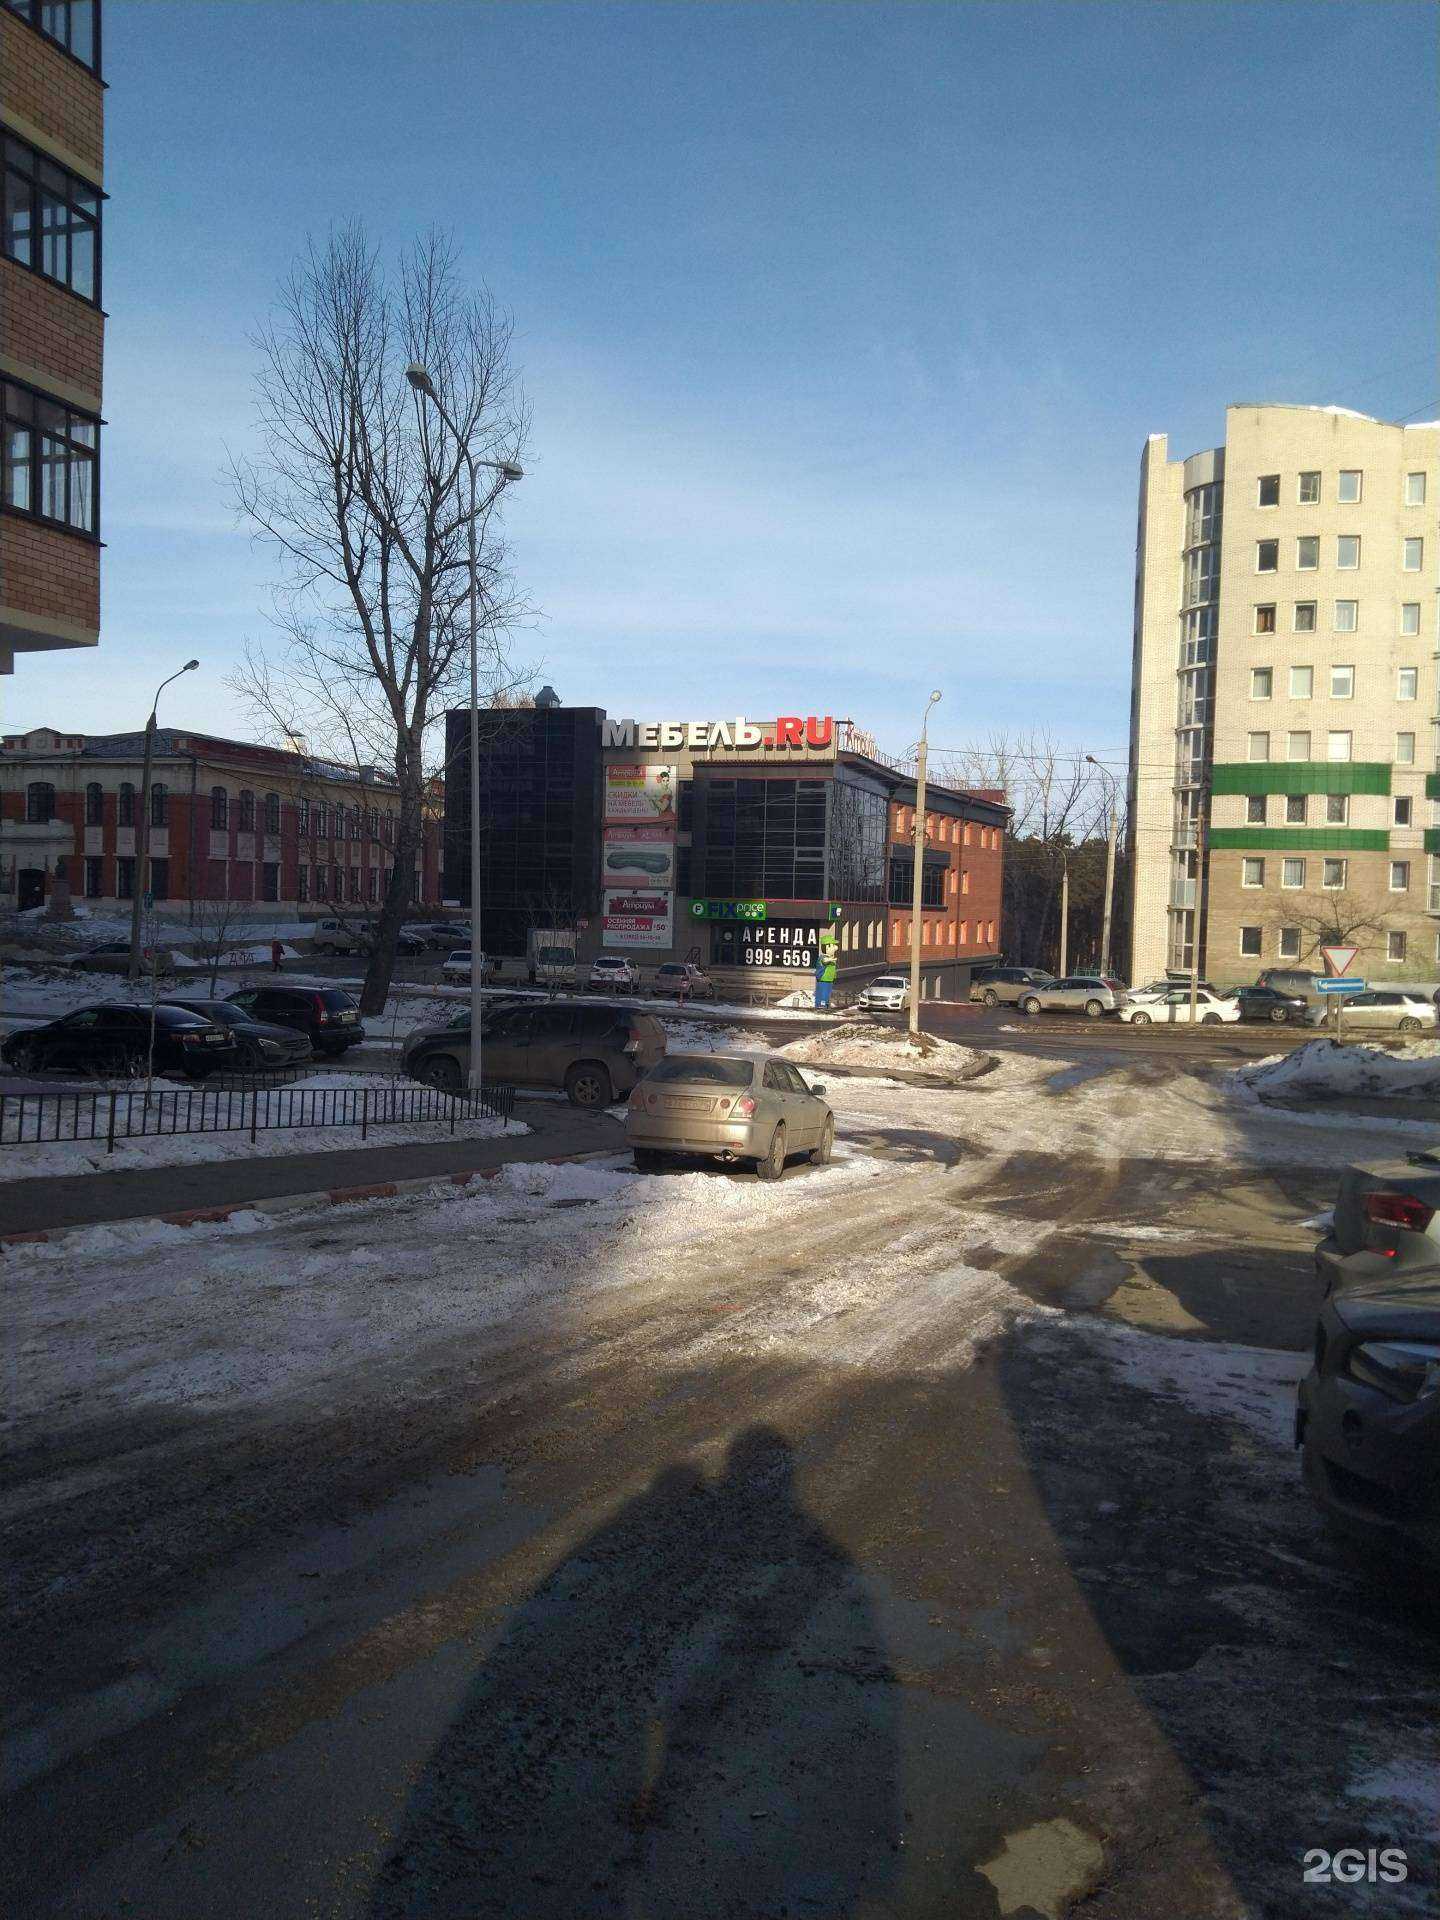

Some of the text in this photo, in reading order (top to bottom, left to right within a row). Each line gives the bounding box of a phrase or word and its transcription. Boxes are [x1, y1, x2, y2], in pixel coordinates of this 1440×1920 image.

[622, 899, 655, 911] Атриум
[736, 903, 764, 913] price
[742, 926, 817, 945] АРЕНДА
[745, 948, 811, 967] 999-559
